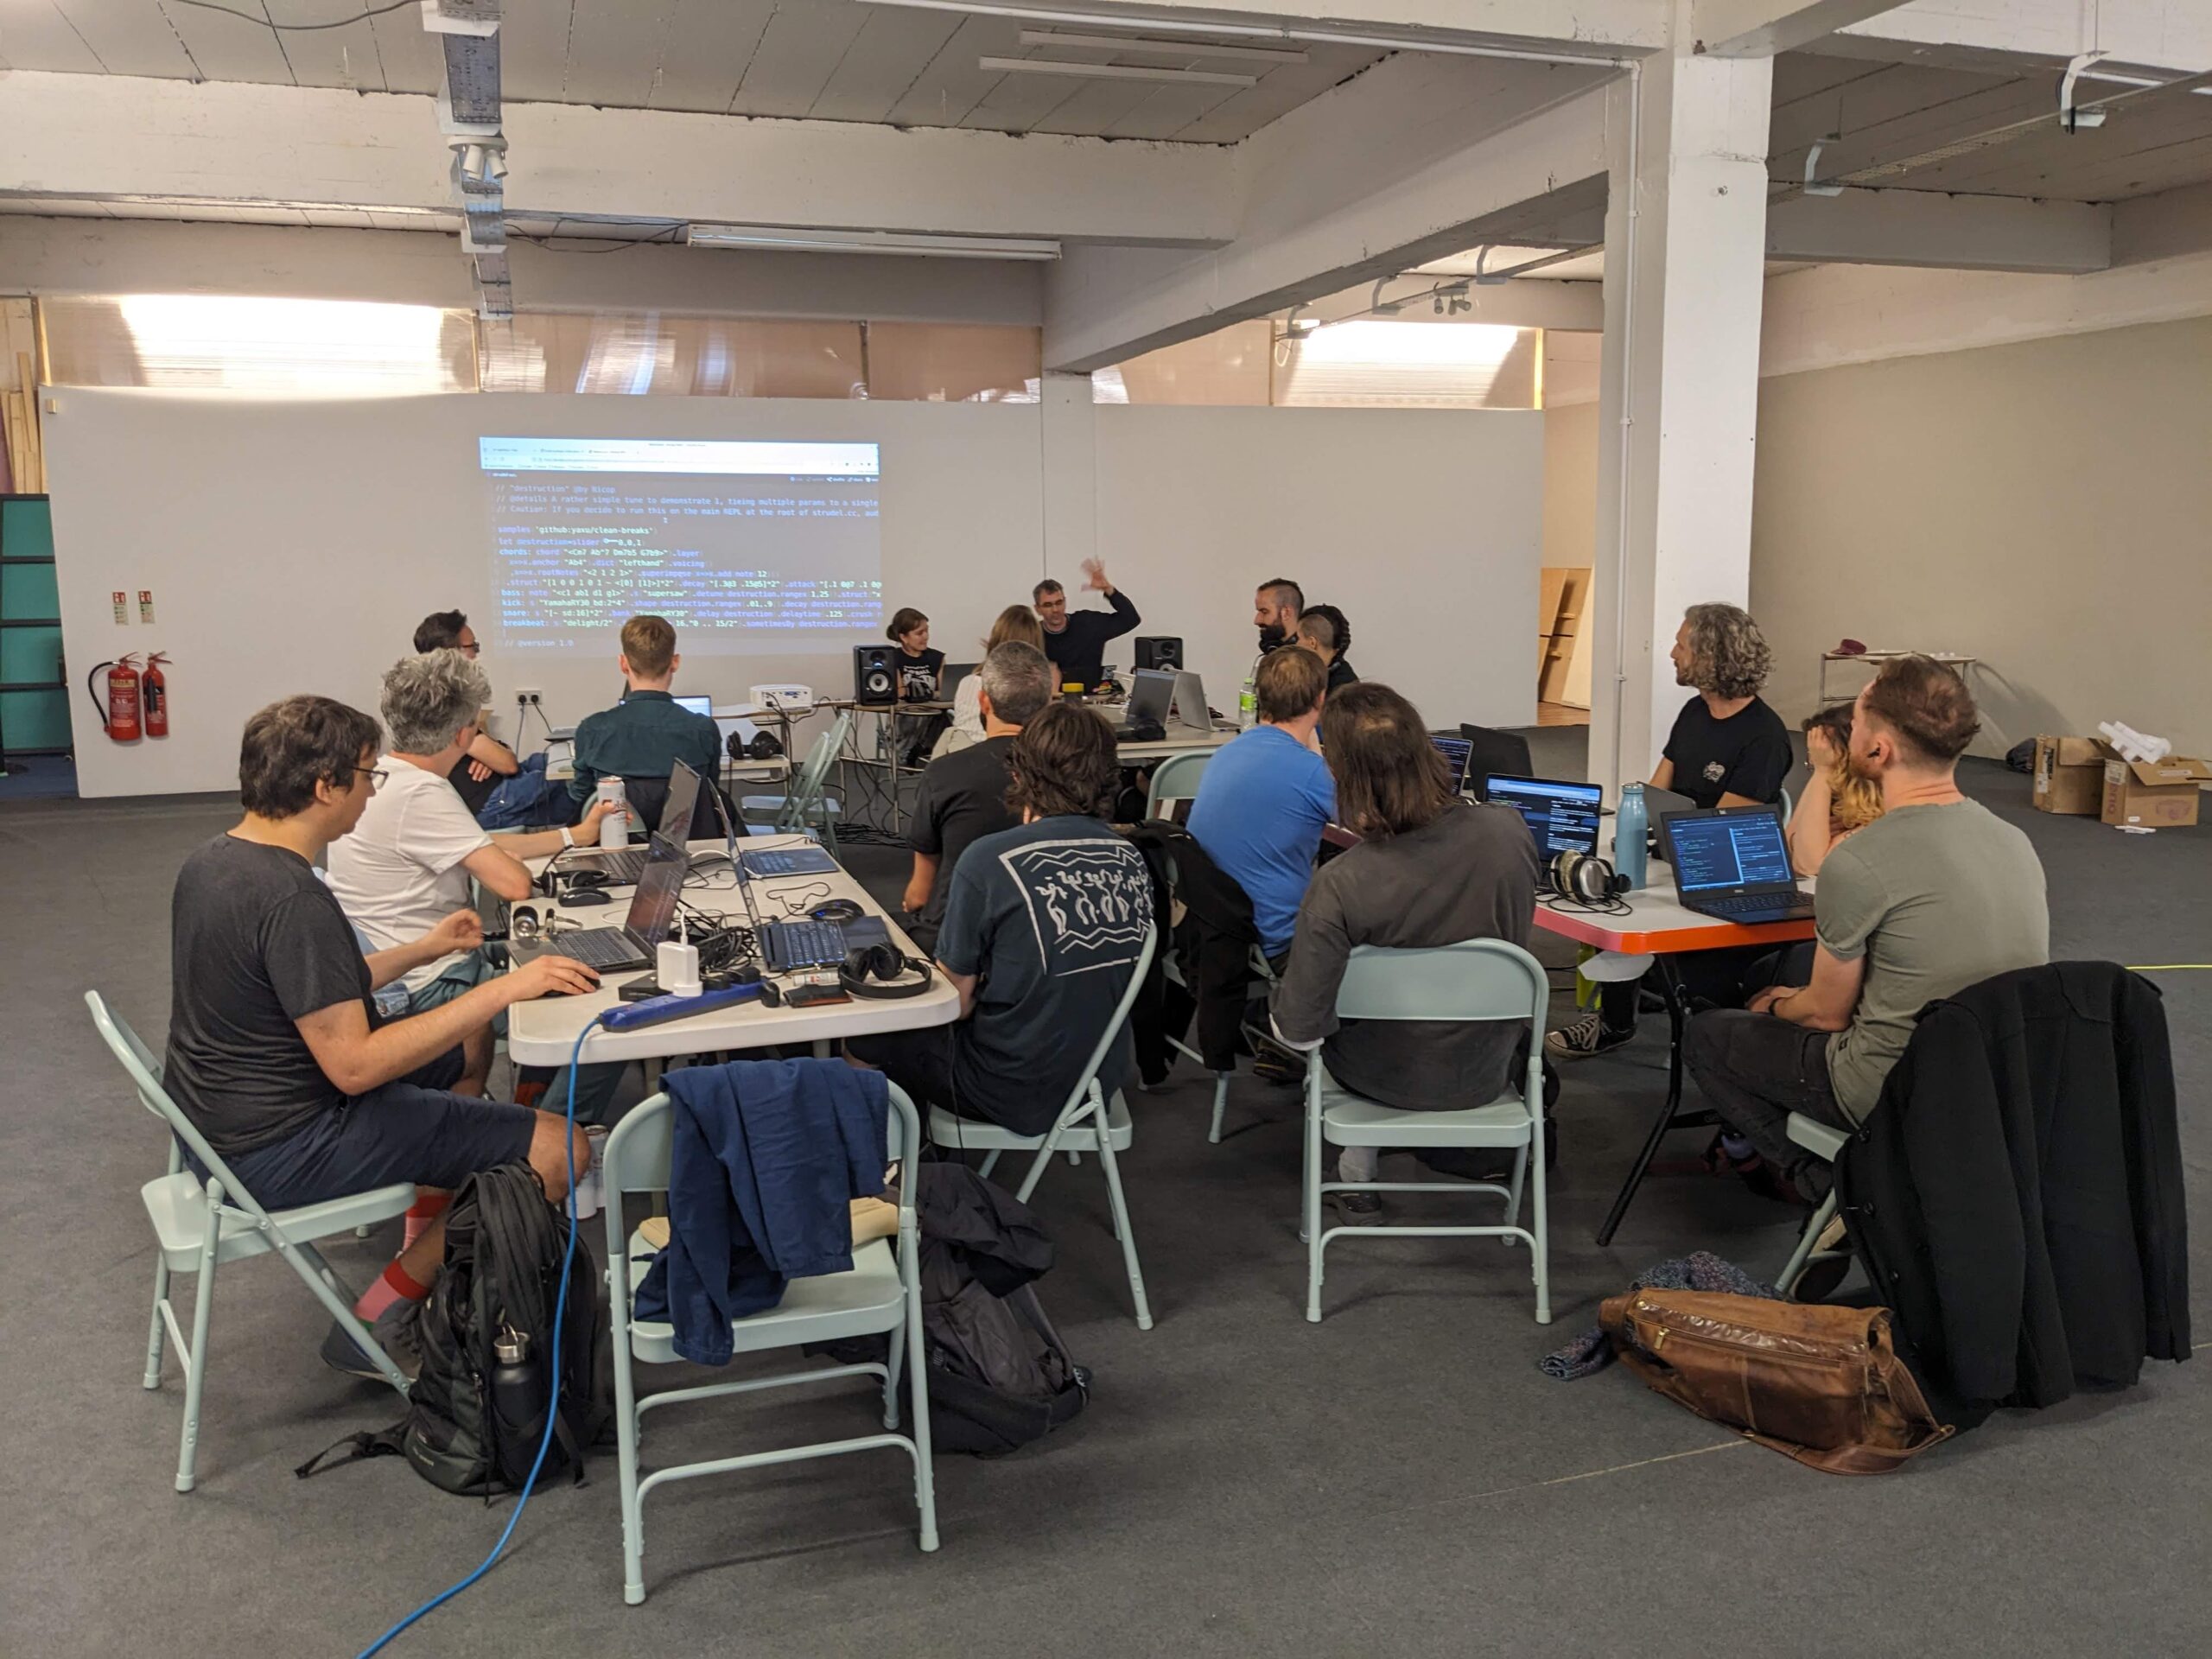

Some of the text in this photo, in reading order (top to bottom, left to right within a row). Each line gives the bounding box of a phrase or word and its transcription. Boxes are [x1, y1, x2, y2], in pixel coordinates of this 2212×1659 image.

[593, 496, 620, 505] simple
[851, 499, 879, 508] single
[498, 526, 531, 535] samples
